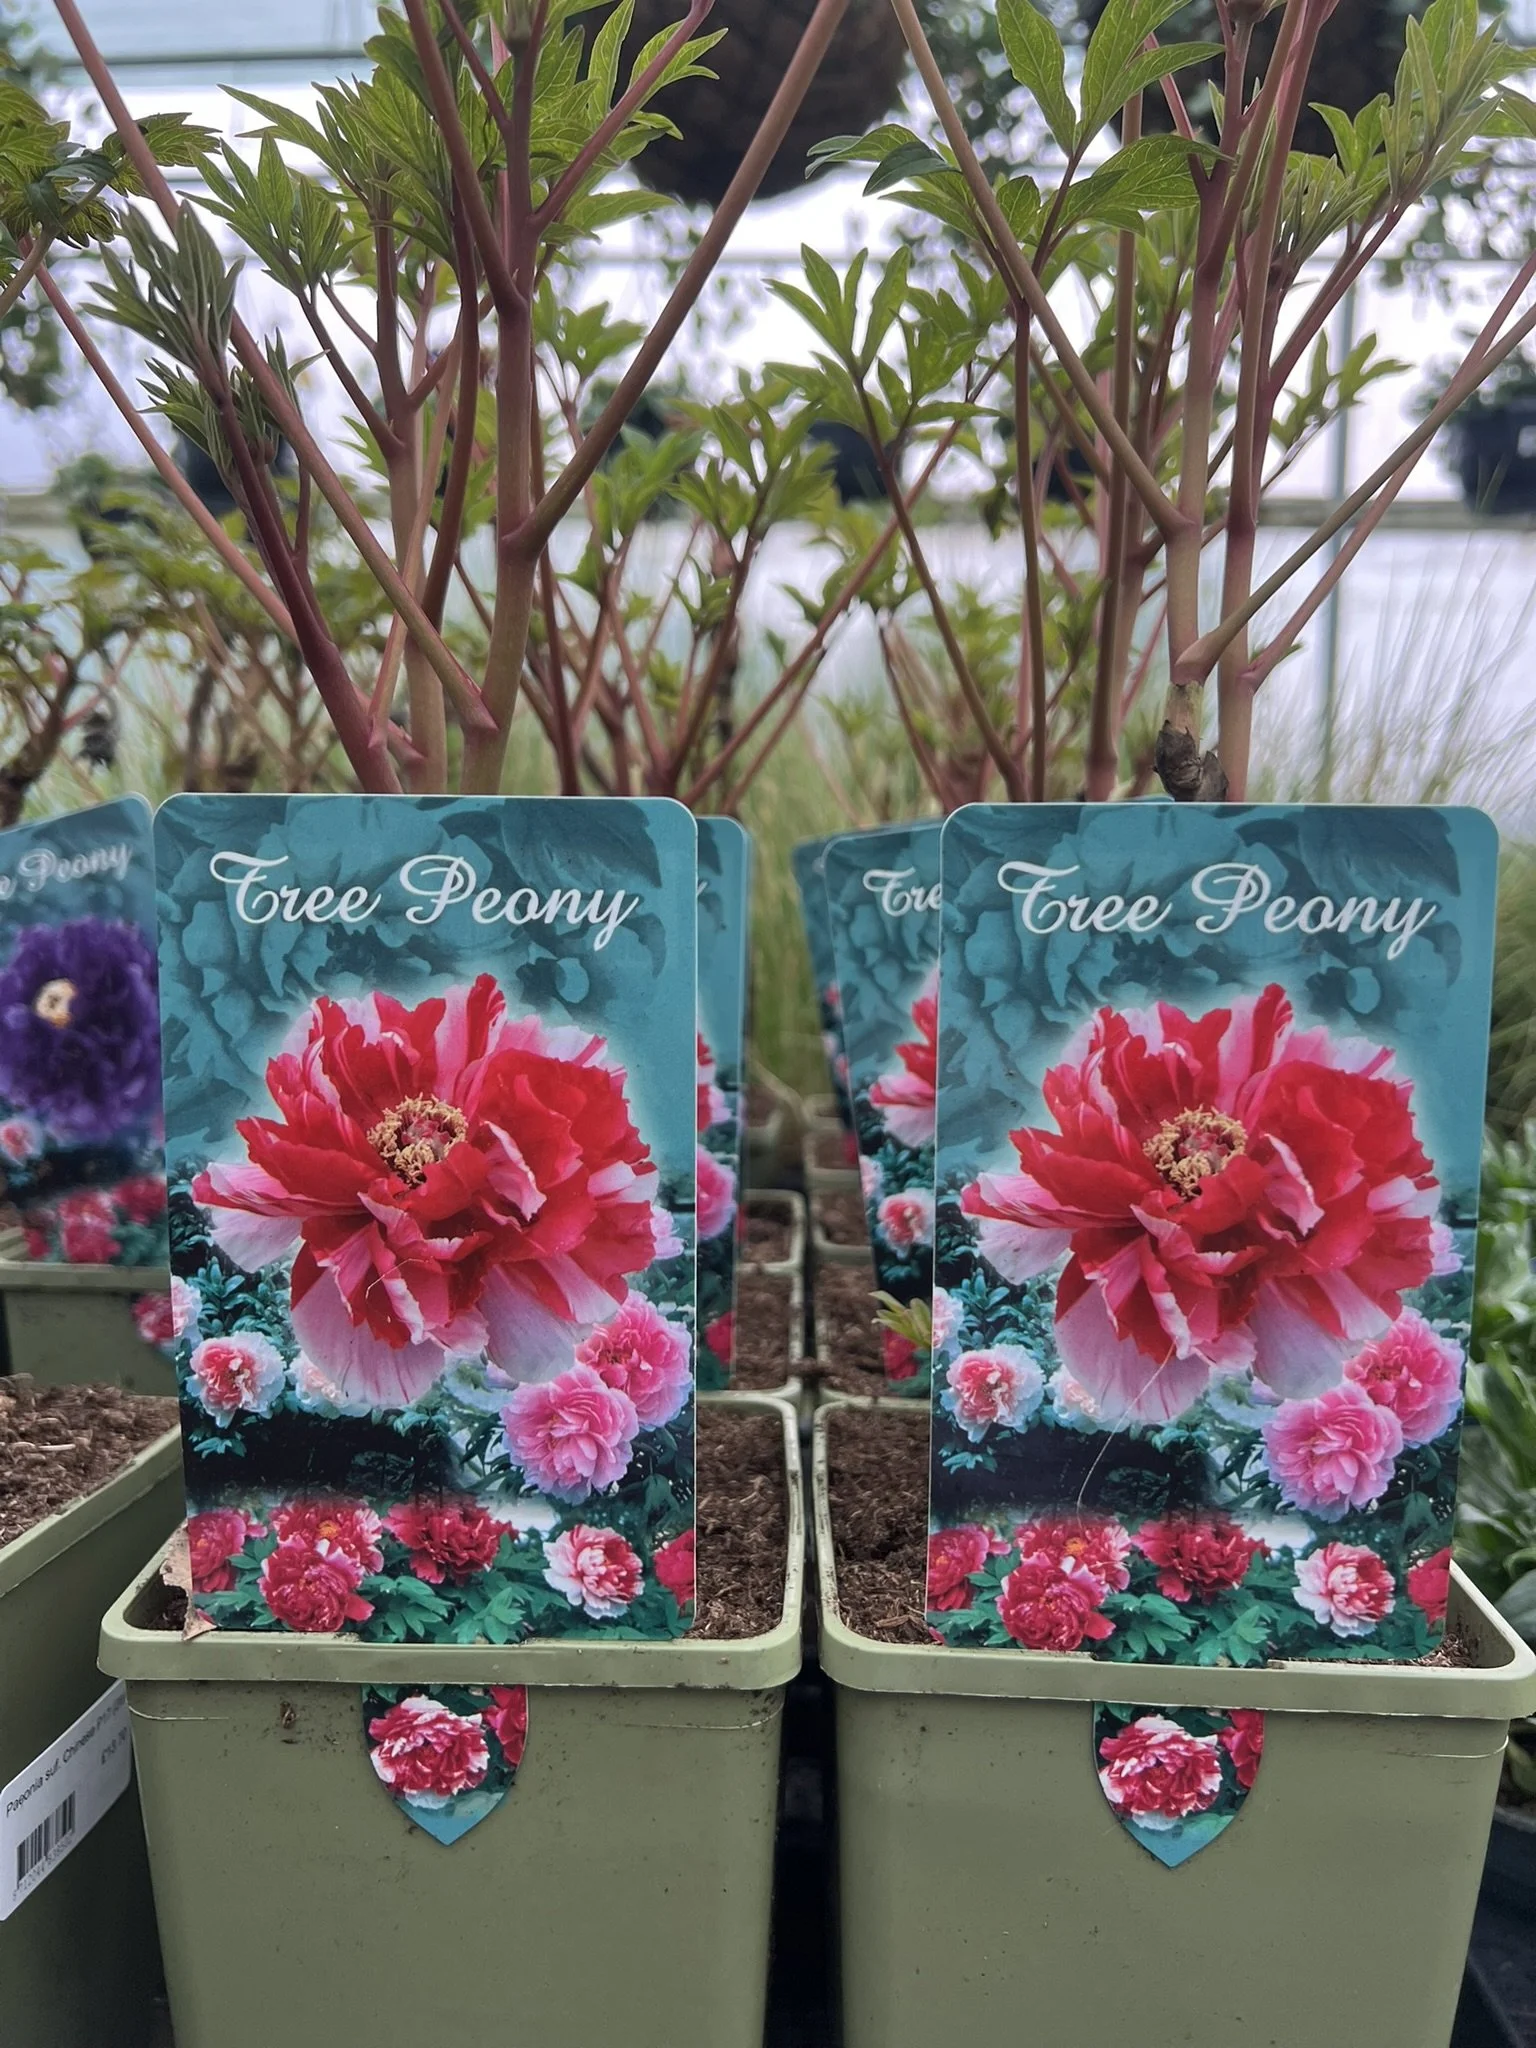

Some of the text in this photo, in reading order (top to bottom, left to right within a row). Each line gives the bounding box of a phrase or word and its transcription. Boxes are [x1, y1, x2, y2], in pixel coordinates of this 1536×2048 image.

[17, 842, 133, 893] Peony
[862, 866, 942, 917] Tre
[209, 851, 640, 952] Tree Peony
[997, 861, 1437, 961] Tree Peony
[6, 1776, 44, 1818] Paeonia
